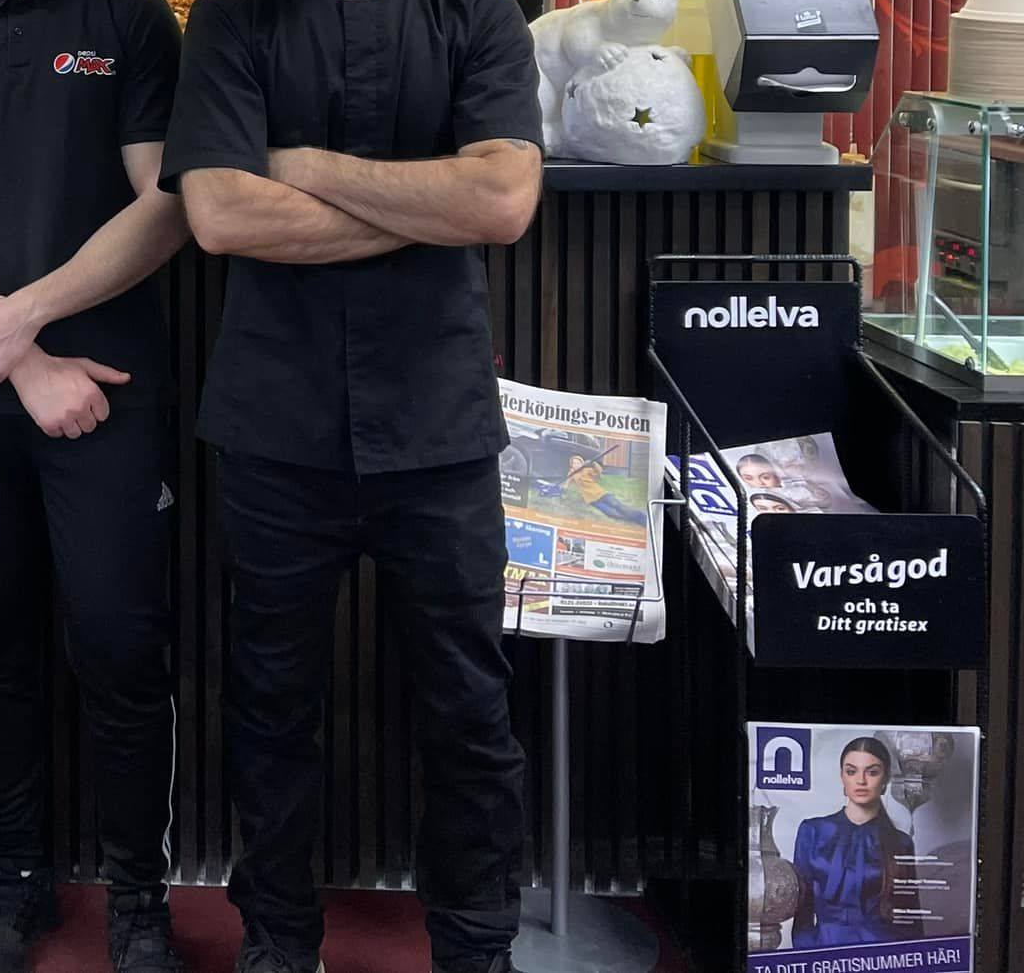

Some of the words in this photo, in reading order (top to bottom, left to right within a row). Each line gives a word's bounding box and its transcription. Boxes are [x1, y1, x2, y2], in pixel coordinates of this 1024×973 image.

[684, 296, 819, 328] nollelva
[792, 548, 948, 589] Varsågod
[844, 598, 875, 614] och
[881, 600, 899, 614] ta
[817, 616, 851, 632] Ditt
[855, 617, 928, 635] gratisex
[762, 776, 803, 785] nollelva
[755, 965, 772, 973] TA
[777, 963, 807, 973] DITT
[812, 952, 922, 973] GRATISNUMMER
[927, 949, 960, 964] HÄR!
